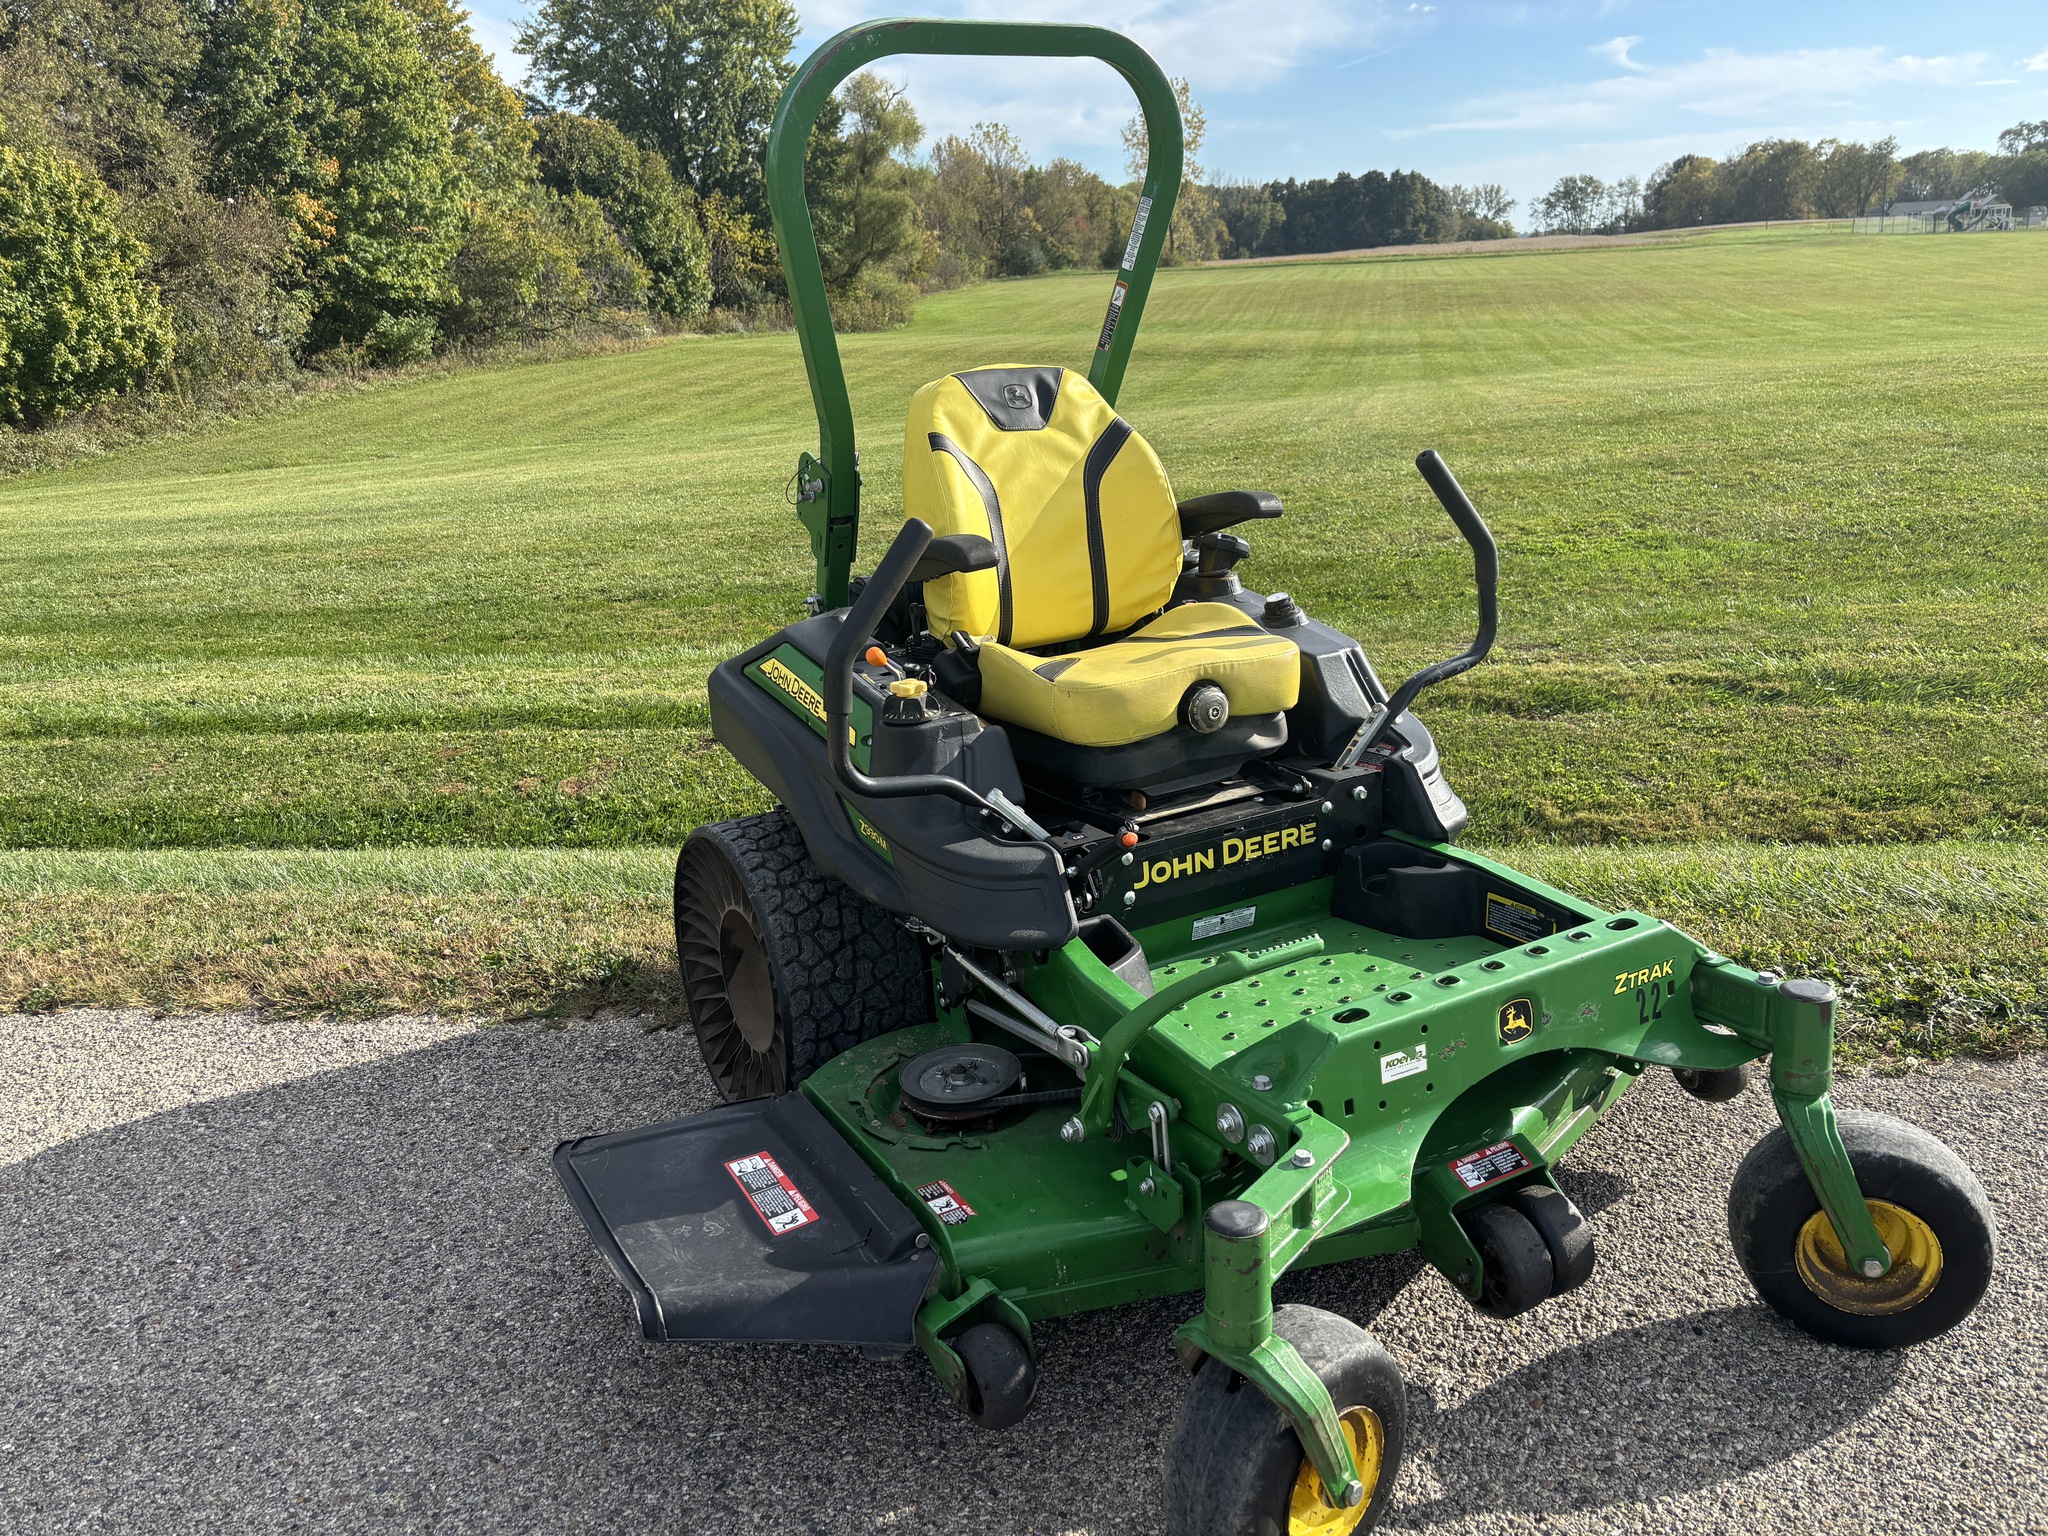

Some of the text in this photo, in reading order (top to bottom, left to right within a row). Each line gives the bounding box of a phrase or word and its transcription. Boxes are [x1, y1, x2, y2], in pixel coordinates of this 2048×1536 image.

[767, 662, 822, 717] JOHN DEERE
[1134, 822, 1317, 890] JOHN DEERE
[1614, 958, 1674, 995] ZTRAK
[1636, 982, 1662, 1026] 22
